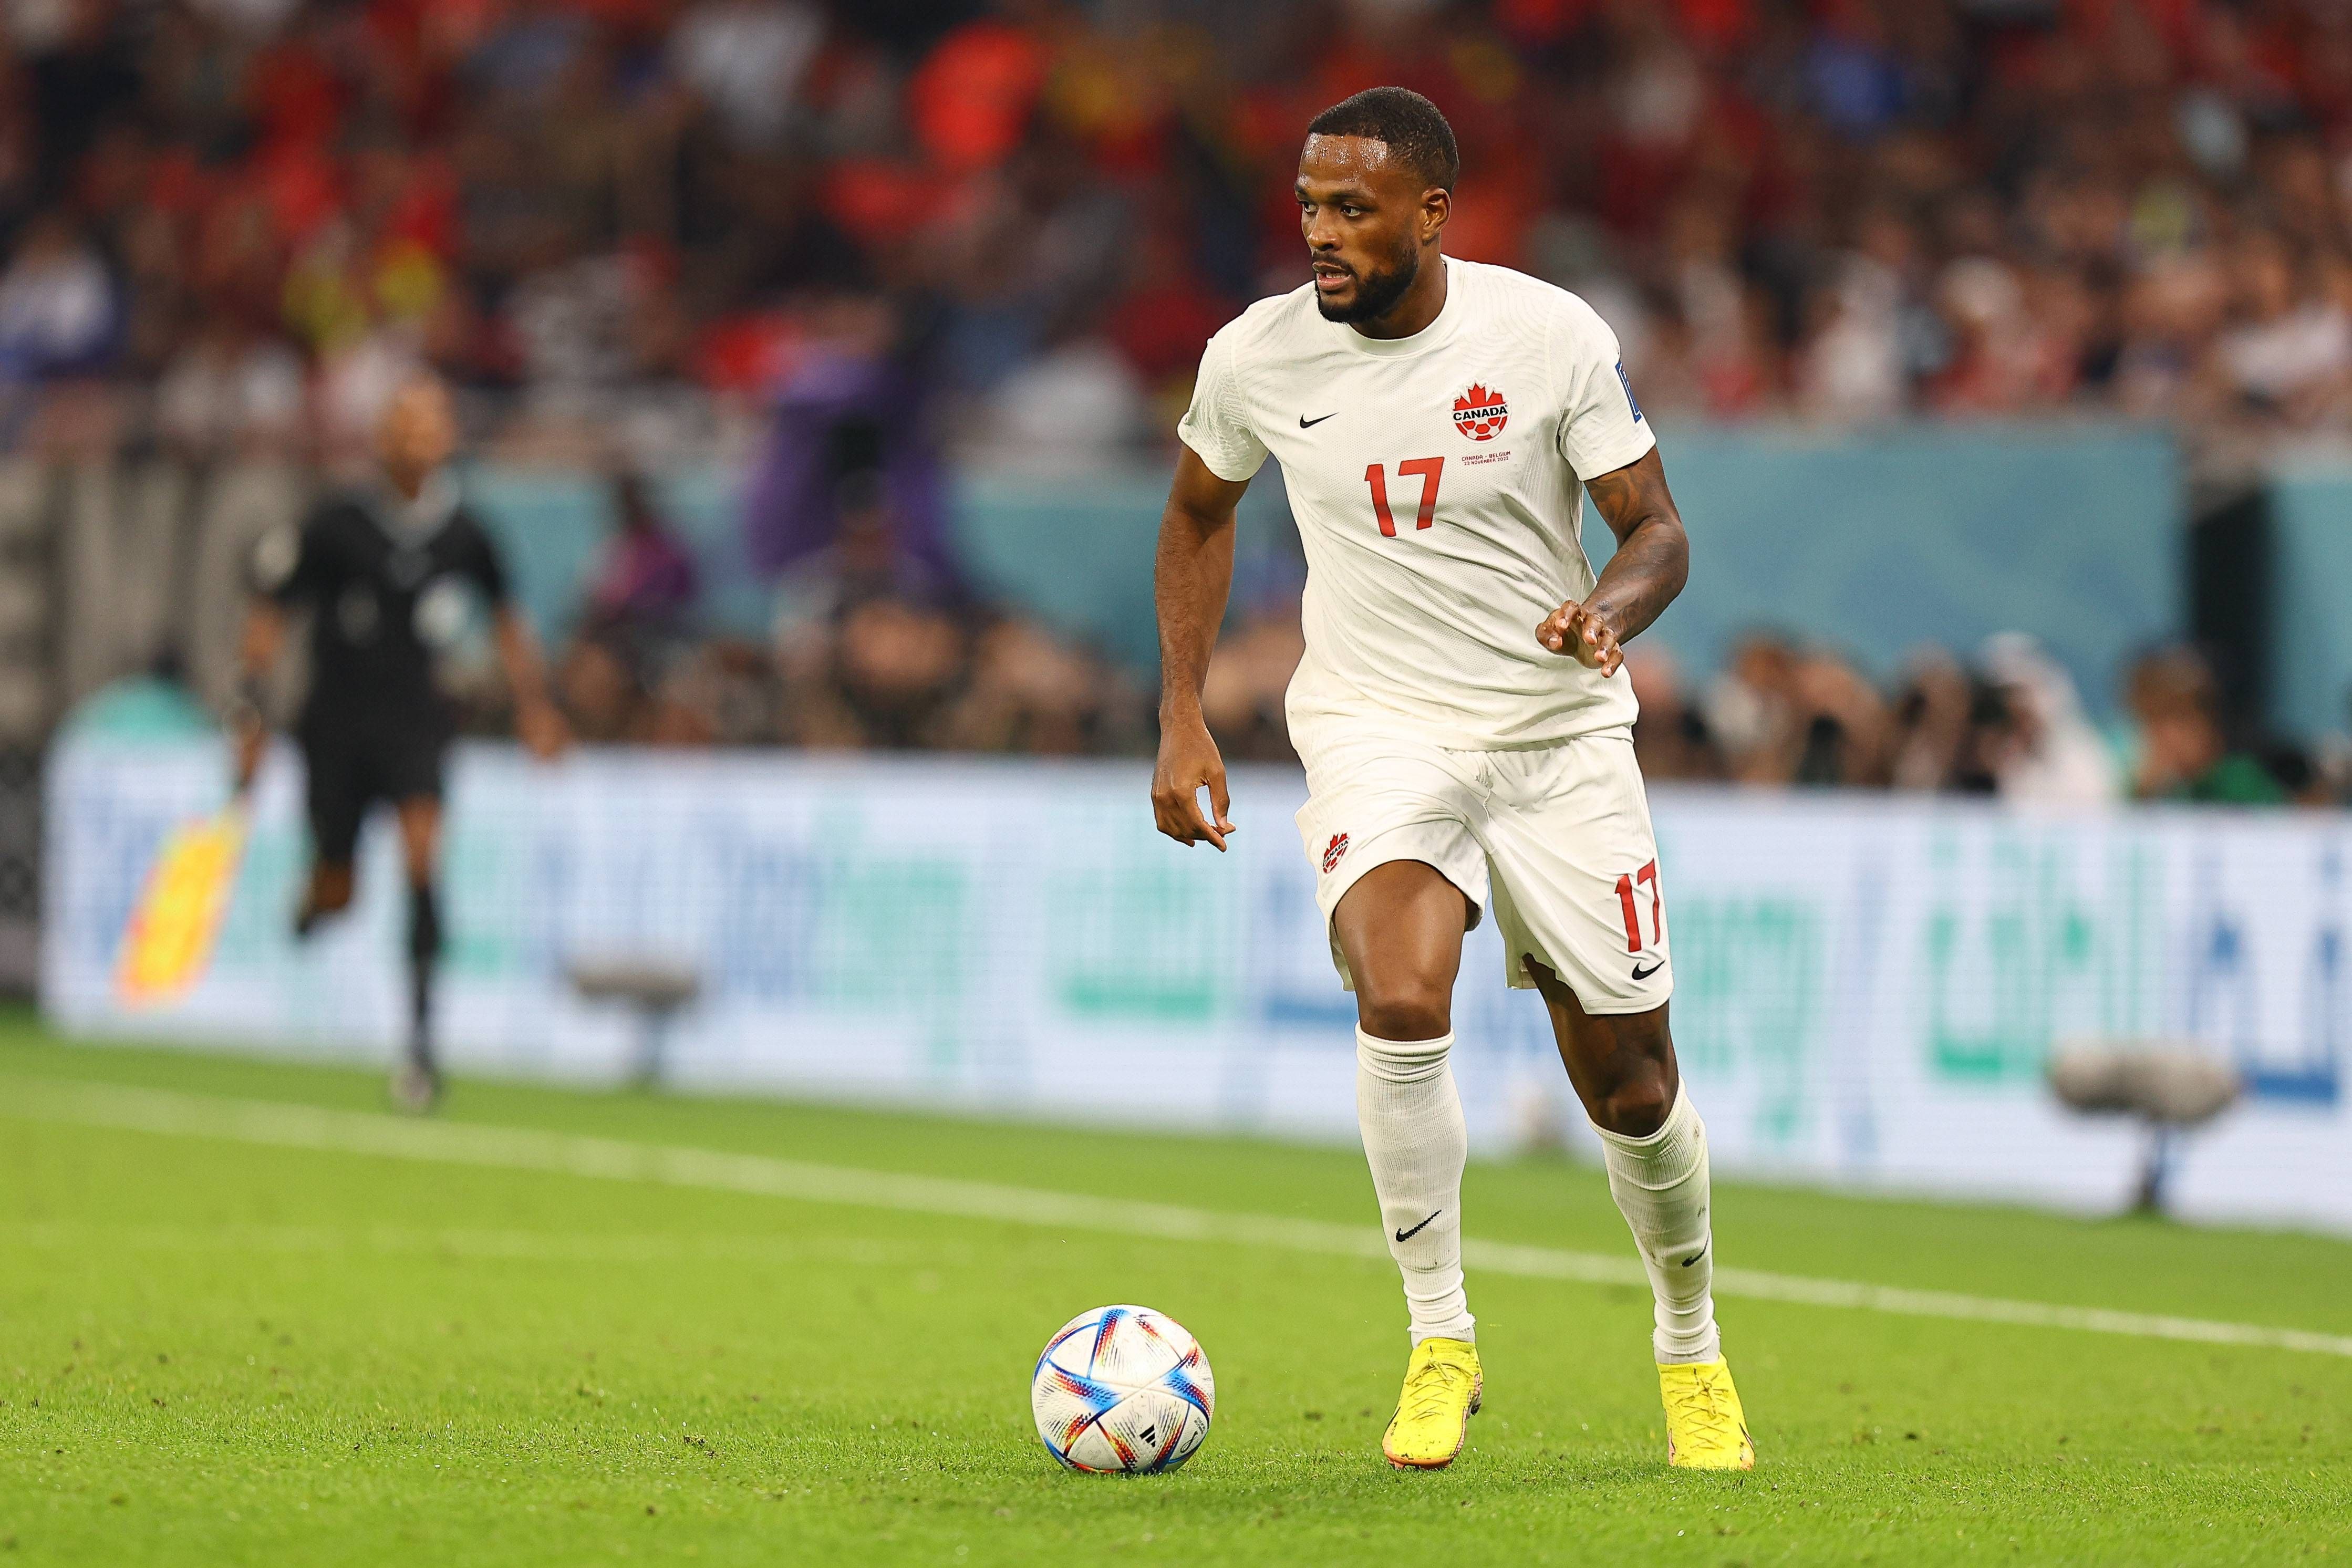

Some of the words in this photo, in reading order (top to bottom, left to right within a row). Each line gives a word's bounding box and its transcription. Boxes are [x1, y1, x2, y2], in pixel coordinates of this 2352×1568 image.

[1453, 406, 1508, 421] CANADA
[1364, 456, 1444, 537] 17
[1323, 840, 1349, 867] CANADA
[1614, 857, 1660, 952] 17
